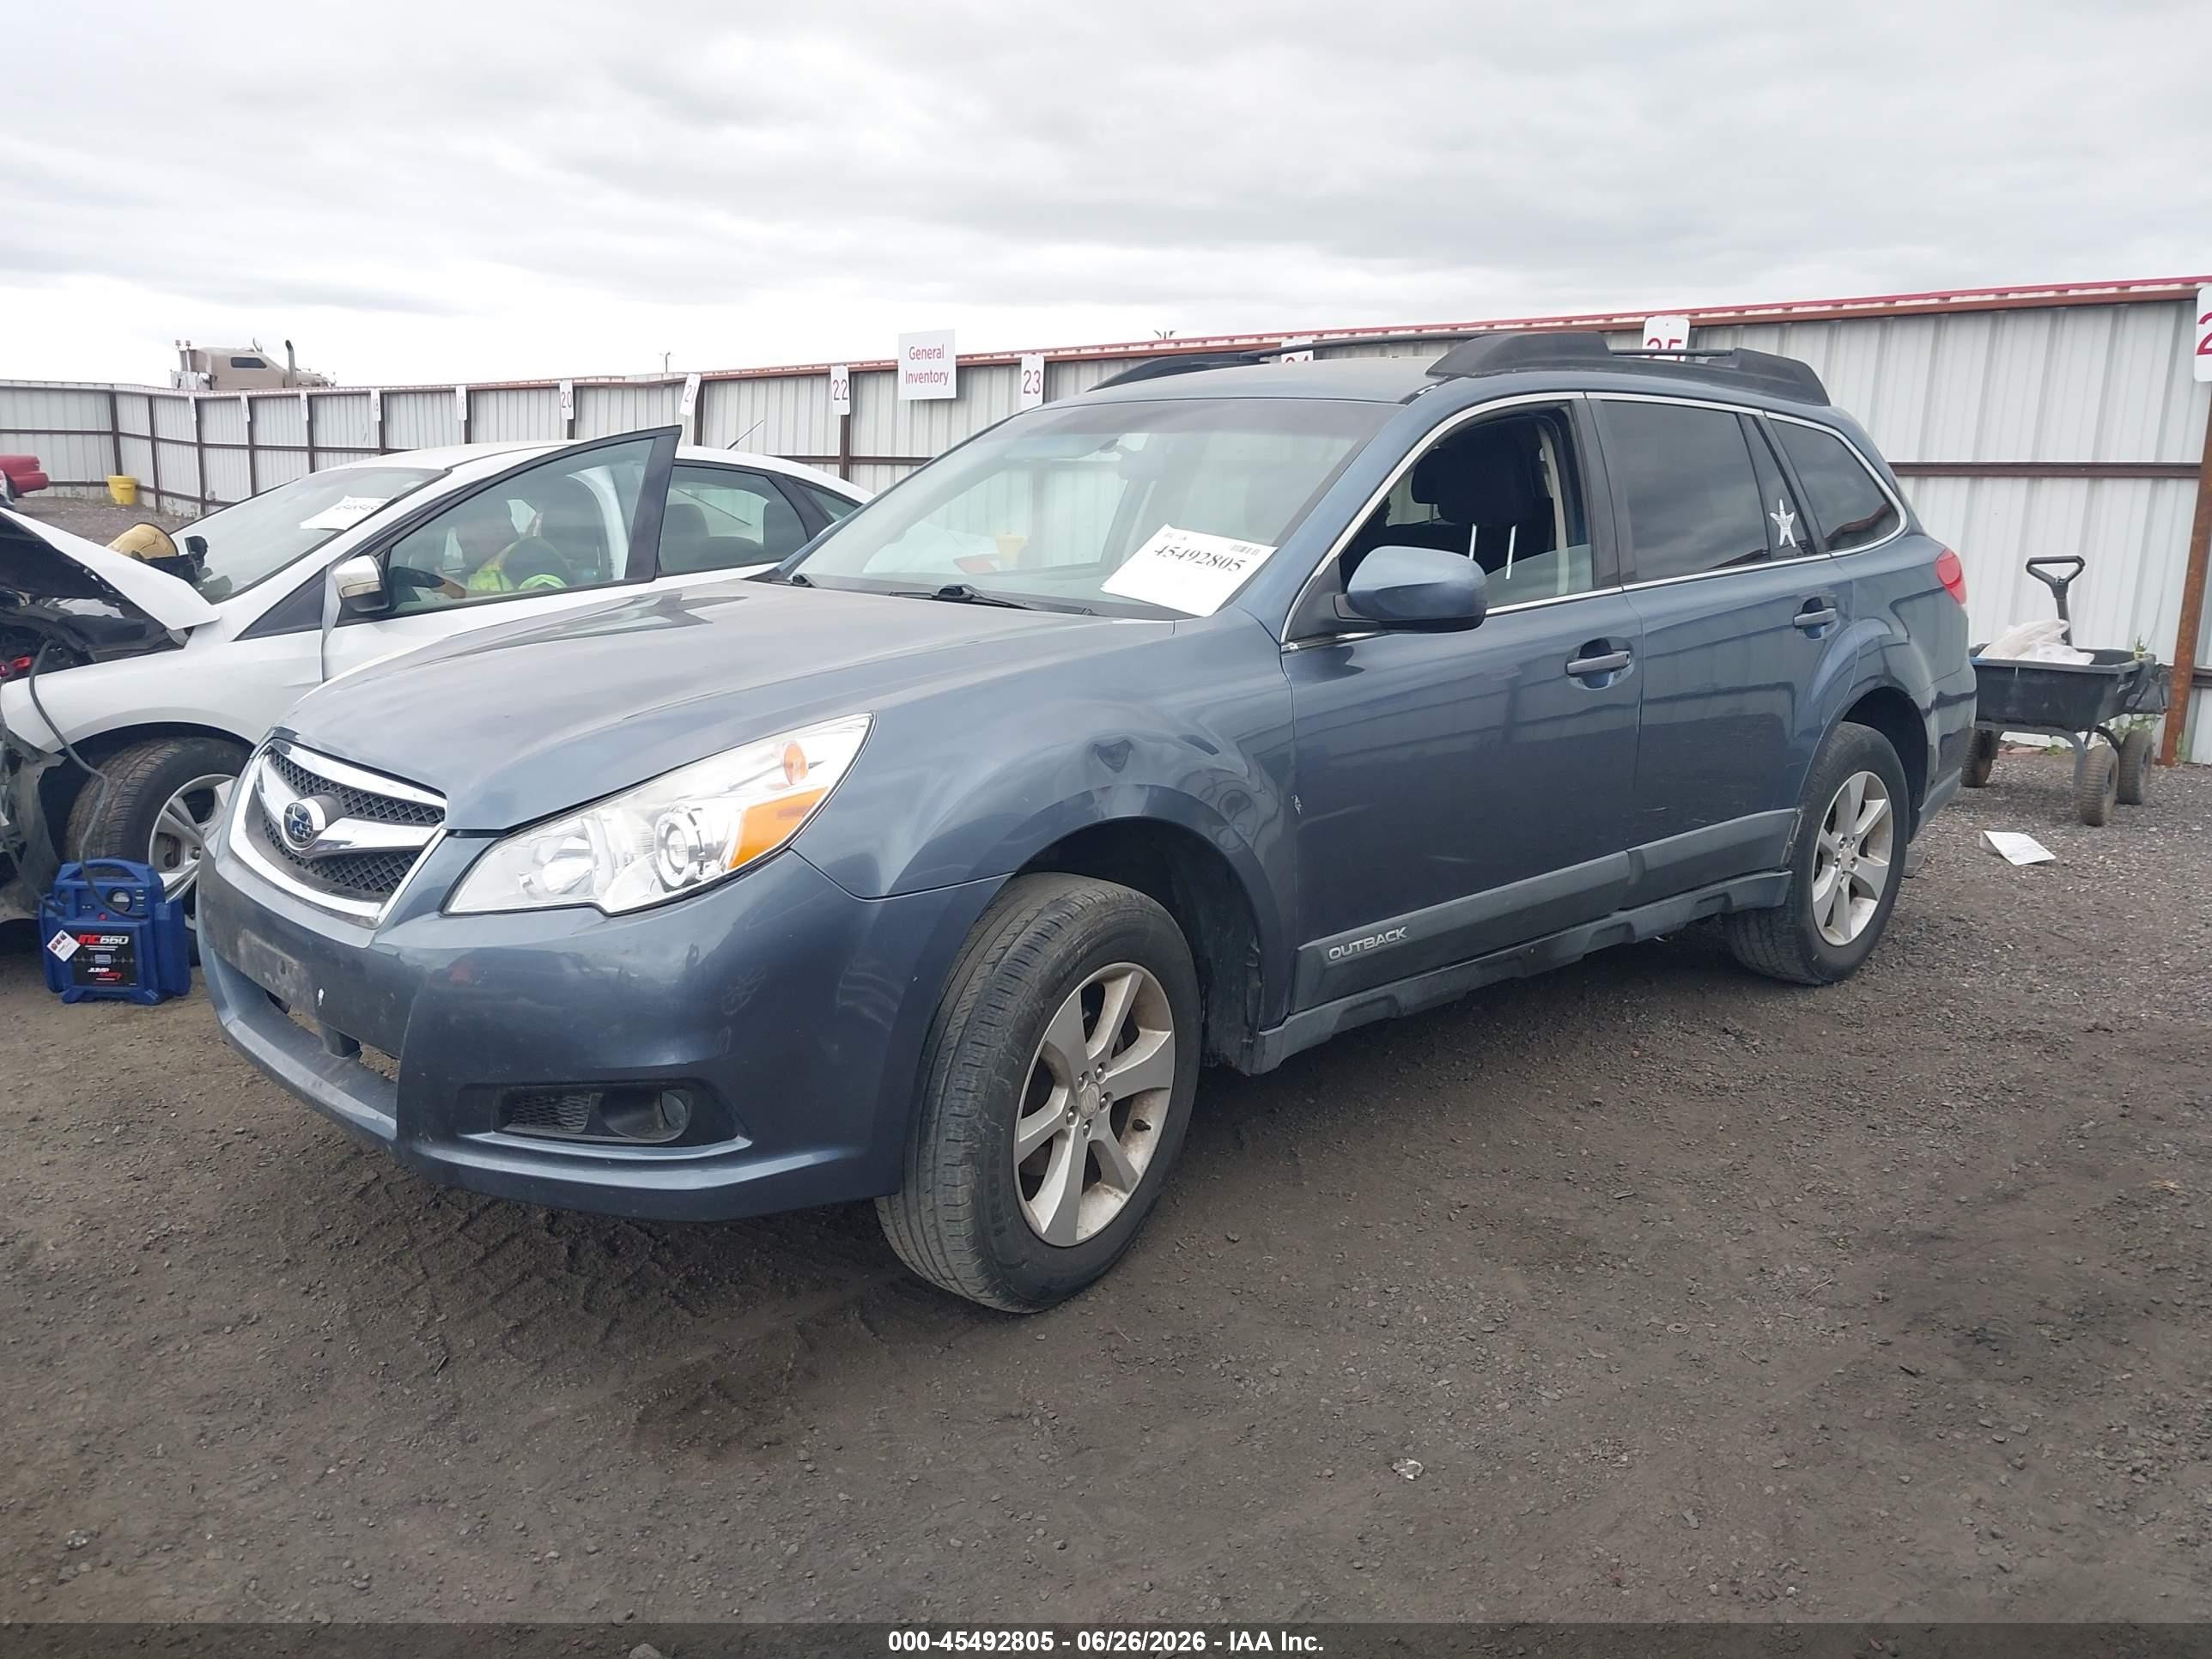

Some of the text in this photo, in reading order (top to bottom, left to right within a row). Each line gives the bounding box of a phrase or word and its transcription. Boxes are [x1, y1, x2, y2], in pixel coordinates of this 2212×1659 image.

[908, 343, 945, 361] General
[905, 369, 949, 386] Inventory
[1023, 369, 1042, 395] 23
[561, 391, 573, 409] 20
[684, 384, 696, 404] 21
[832, 379, 848, 401] 22
[1154, 544, 1247, 572] 45492805
[1328, 927, 1407, 960] OUTBACK
